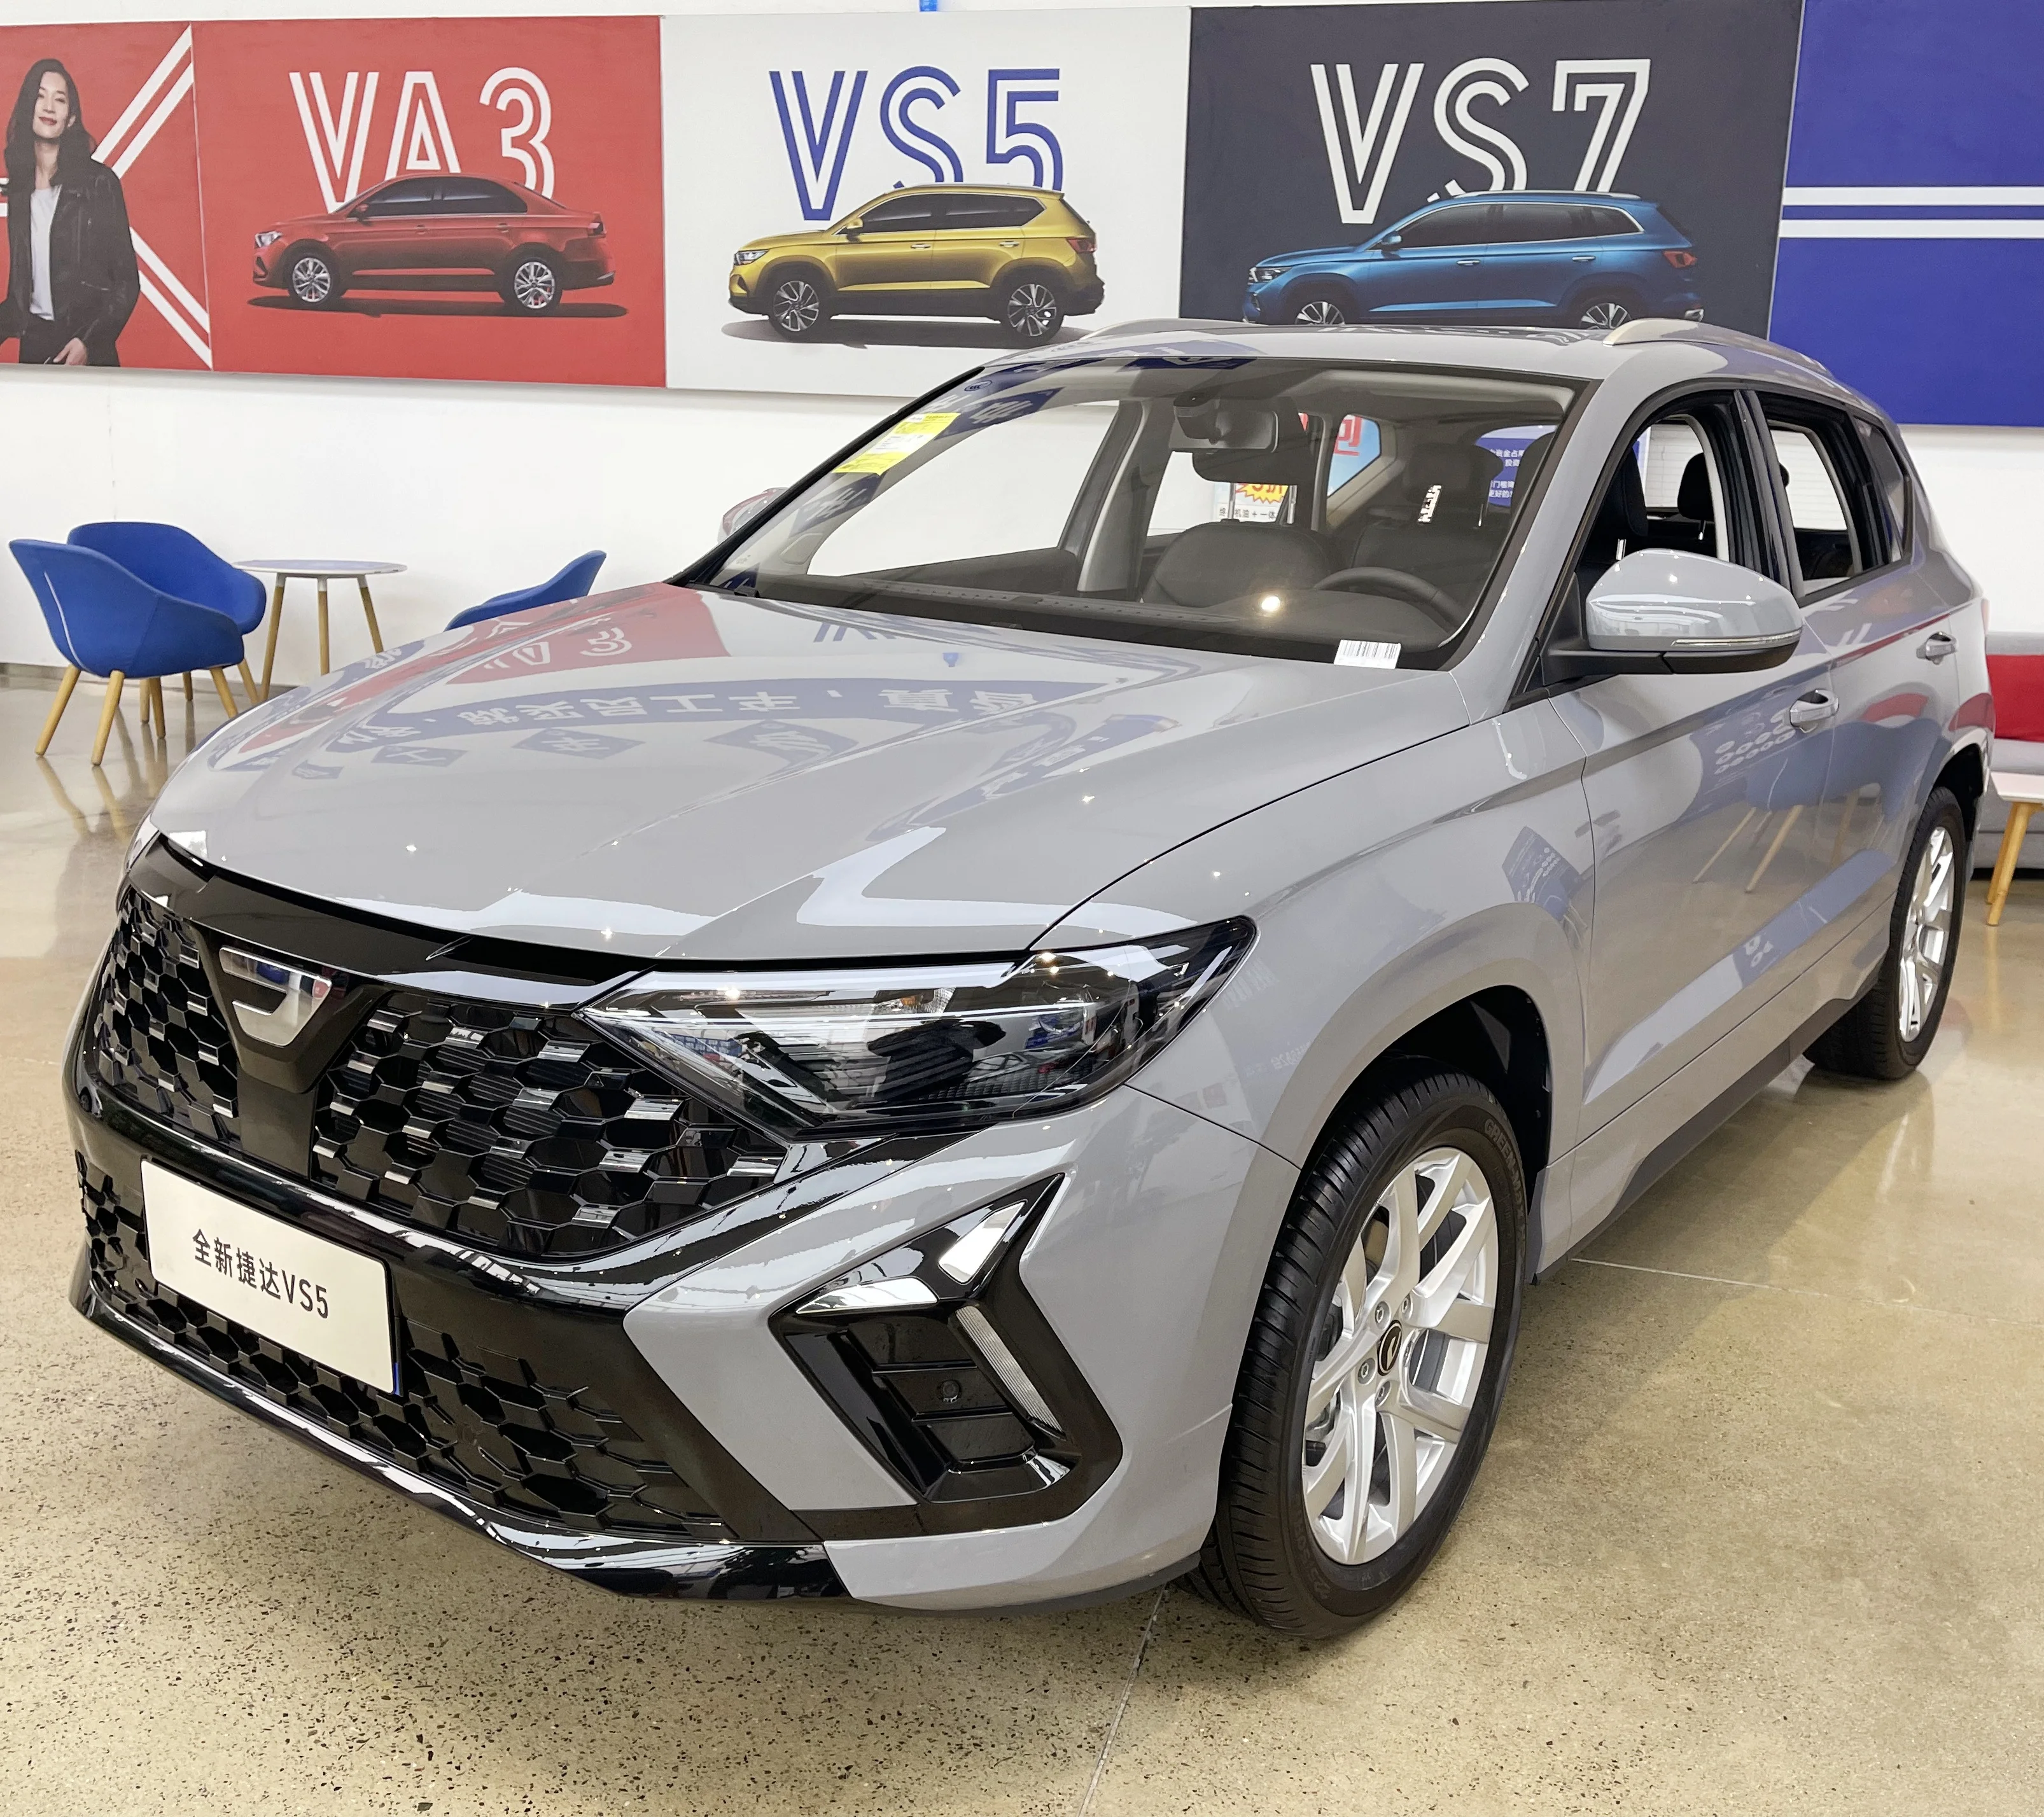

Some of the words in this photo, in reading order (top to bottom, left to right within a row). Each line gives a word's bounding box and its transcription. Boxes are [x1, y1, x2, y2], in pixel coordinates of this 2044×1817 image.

[289, 67, 555, 213] VA3
[769, 66, 1063, 221] VS5
[1310, 58, 1651, 225] VS7
[192, 1229, 328, 1319] 全新捷达VS5
